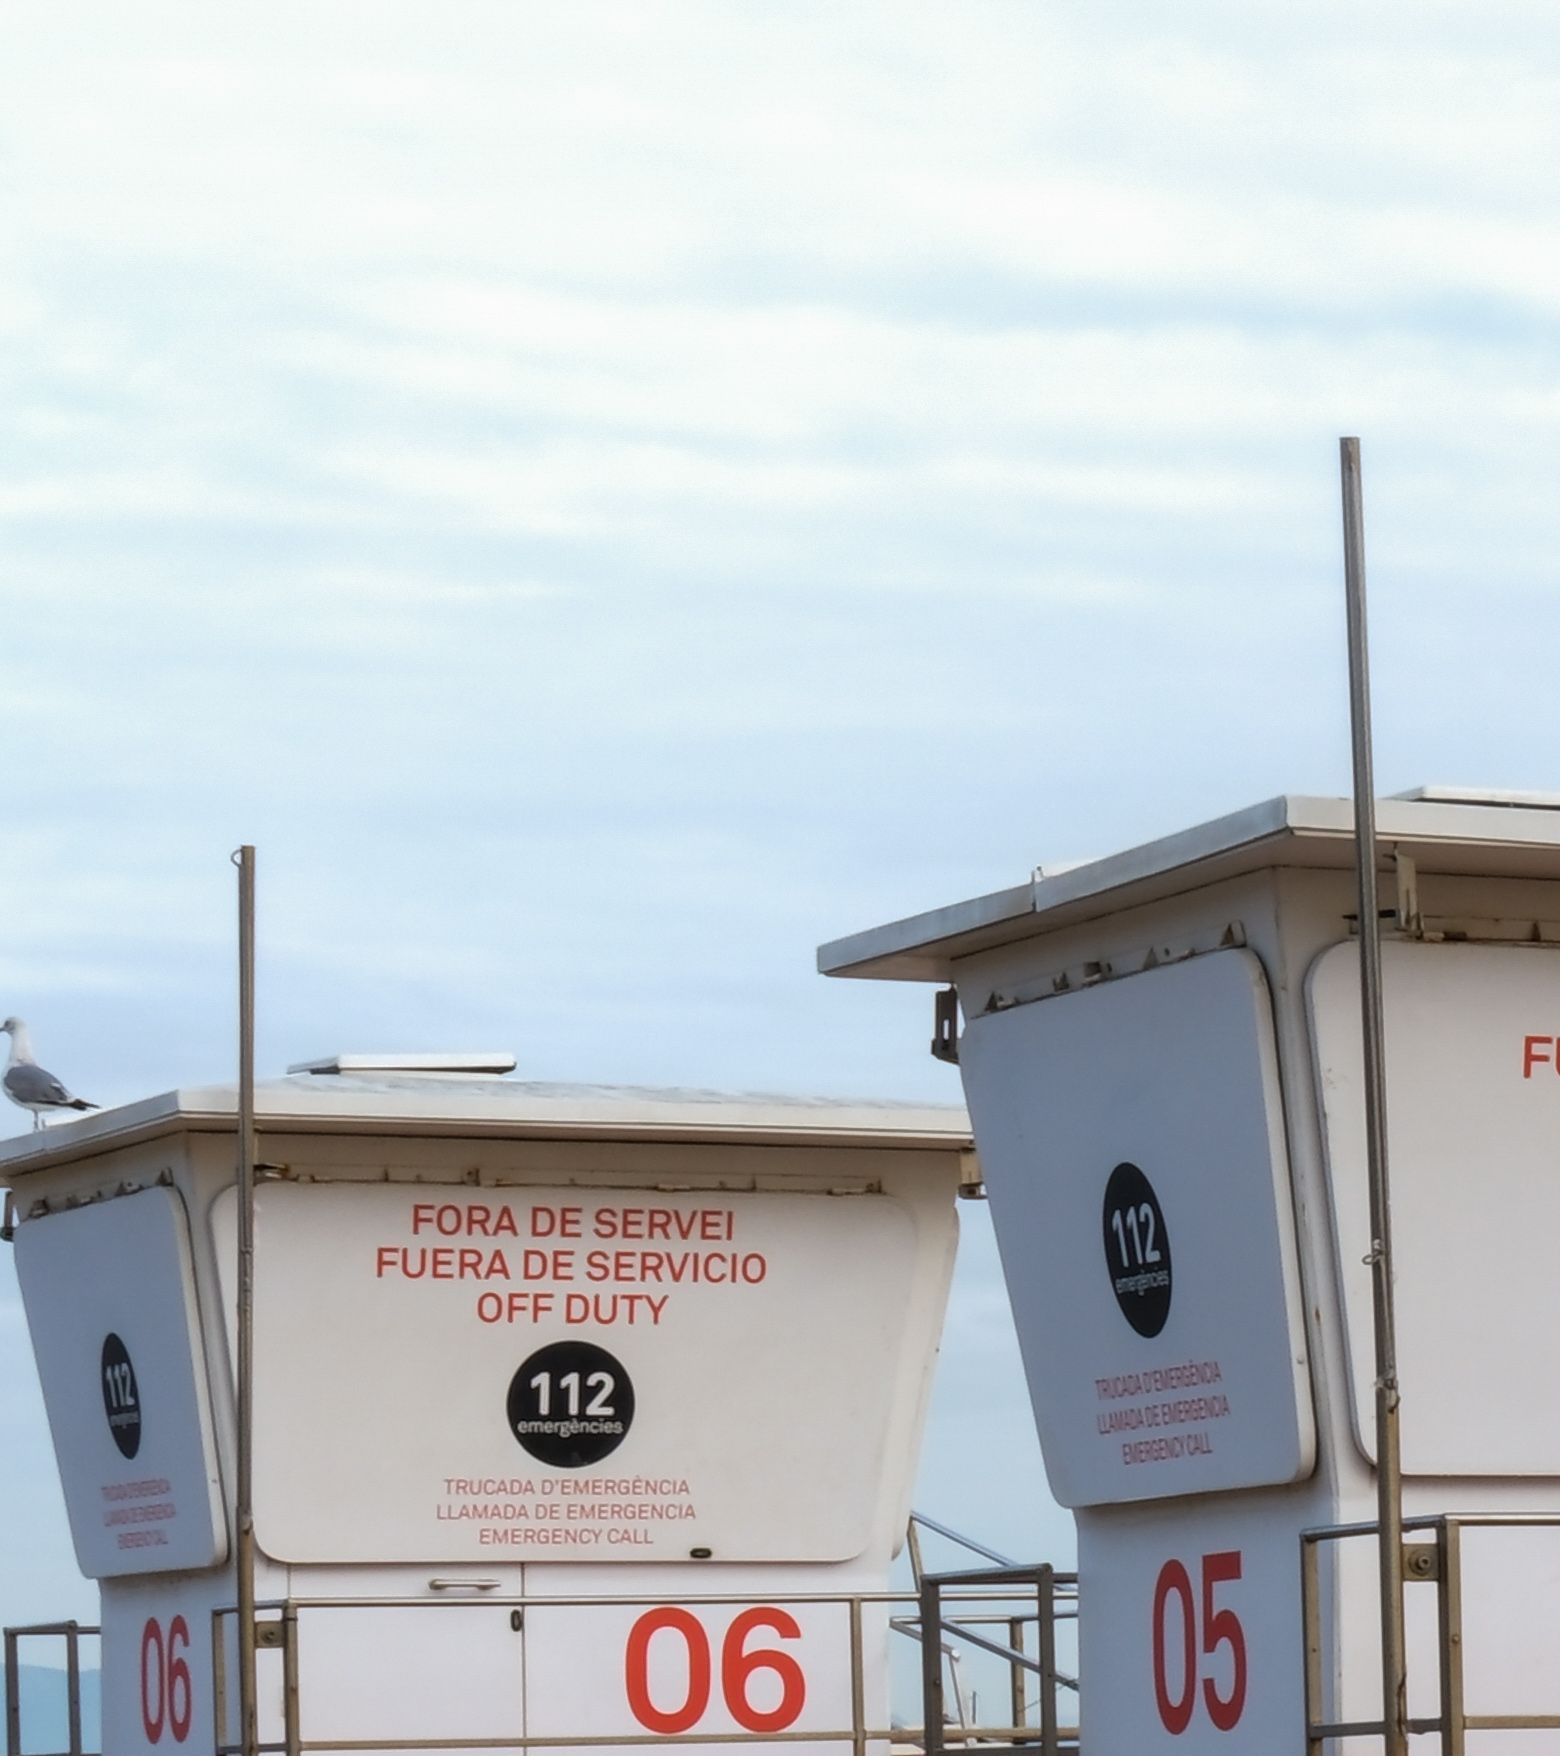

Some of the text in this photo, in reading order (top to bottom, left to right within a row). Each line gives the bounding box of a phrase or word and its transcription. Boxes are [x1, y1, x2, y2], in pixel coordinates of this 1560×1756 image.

[412, 1204, 734, 1241] FORA DE SERVEI
[1112, 1202, 1162, 1268] 112
[376, 1247, 767, 1284] FUERA DE SERVICIO
[477, 1292, 670, 1325] OFF DUTY
[530, 1372, 615, 1416] 112
[517, 1418, 624, 1438] emergències
[444, 1478, 535, 1495] TRUCADA
[436, 1504, 697, 1520] LLAMADA DE EMERGENCIA
[479, 1528, 654, 1545] EMERGENCY CALL
[1152, 1551, 1247, 1735] 05
[141, 1614, 192, 1744] 06
[625, 1606, 807, 1735] 06
